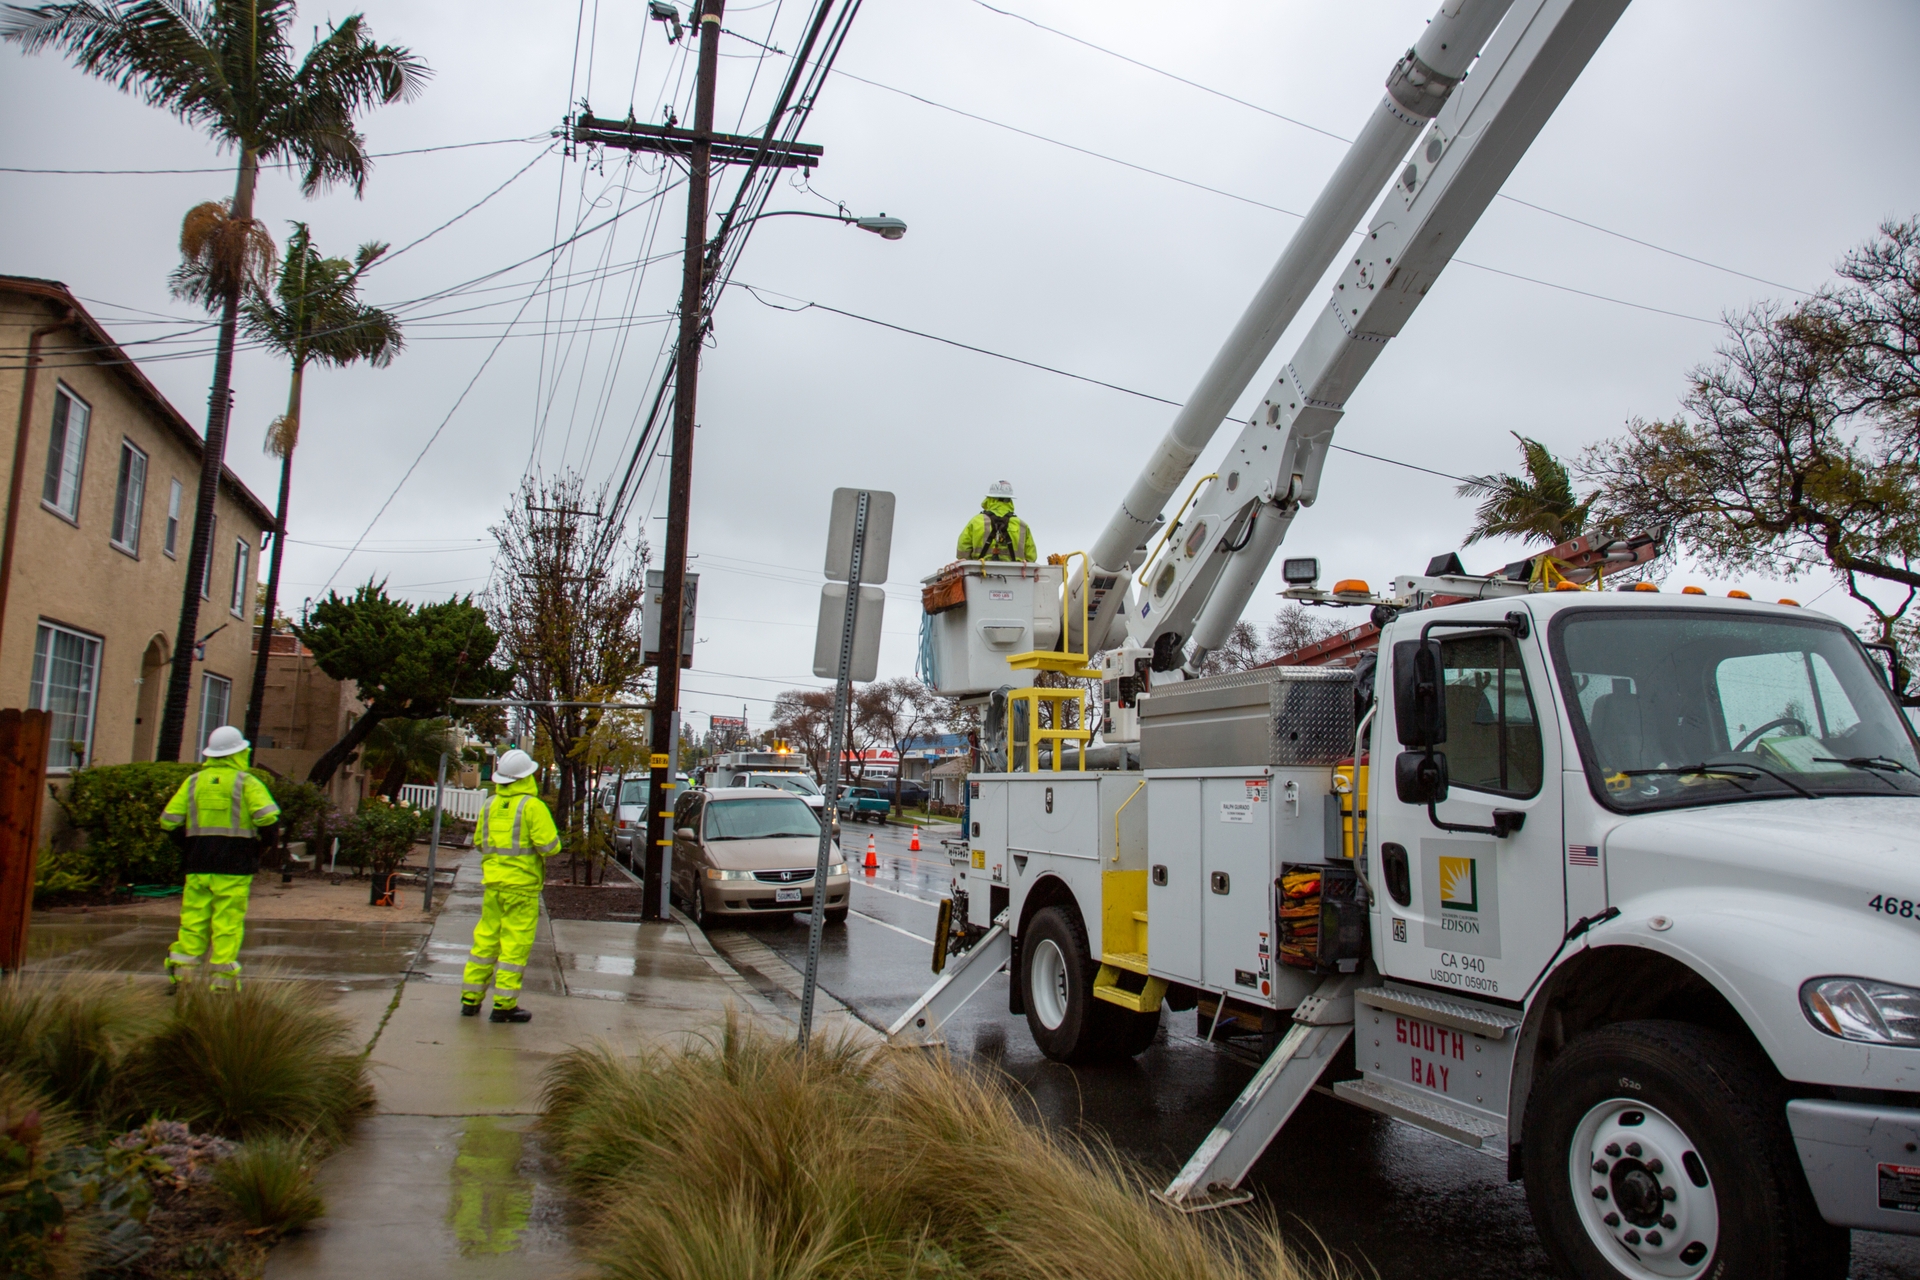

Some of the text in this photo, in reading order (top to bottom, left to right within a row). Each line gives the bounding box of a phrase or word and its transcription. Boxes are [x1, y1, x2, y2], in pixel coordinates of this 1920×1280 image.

[1394, 925, 1405, 940] 45
[1441, 918, 1480, 934] EDISON
[1441, 952, 1485, 973] CA 940
[1430, 968, 1498, 993] USDOT 059076
[1396, 1017, 1464, 1061] SOUTH
[1411, 1056, 1449, 1092] BAY
